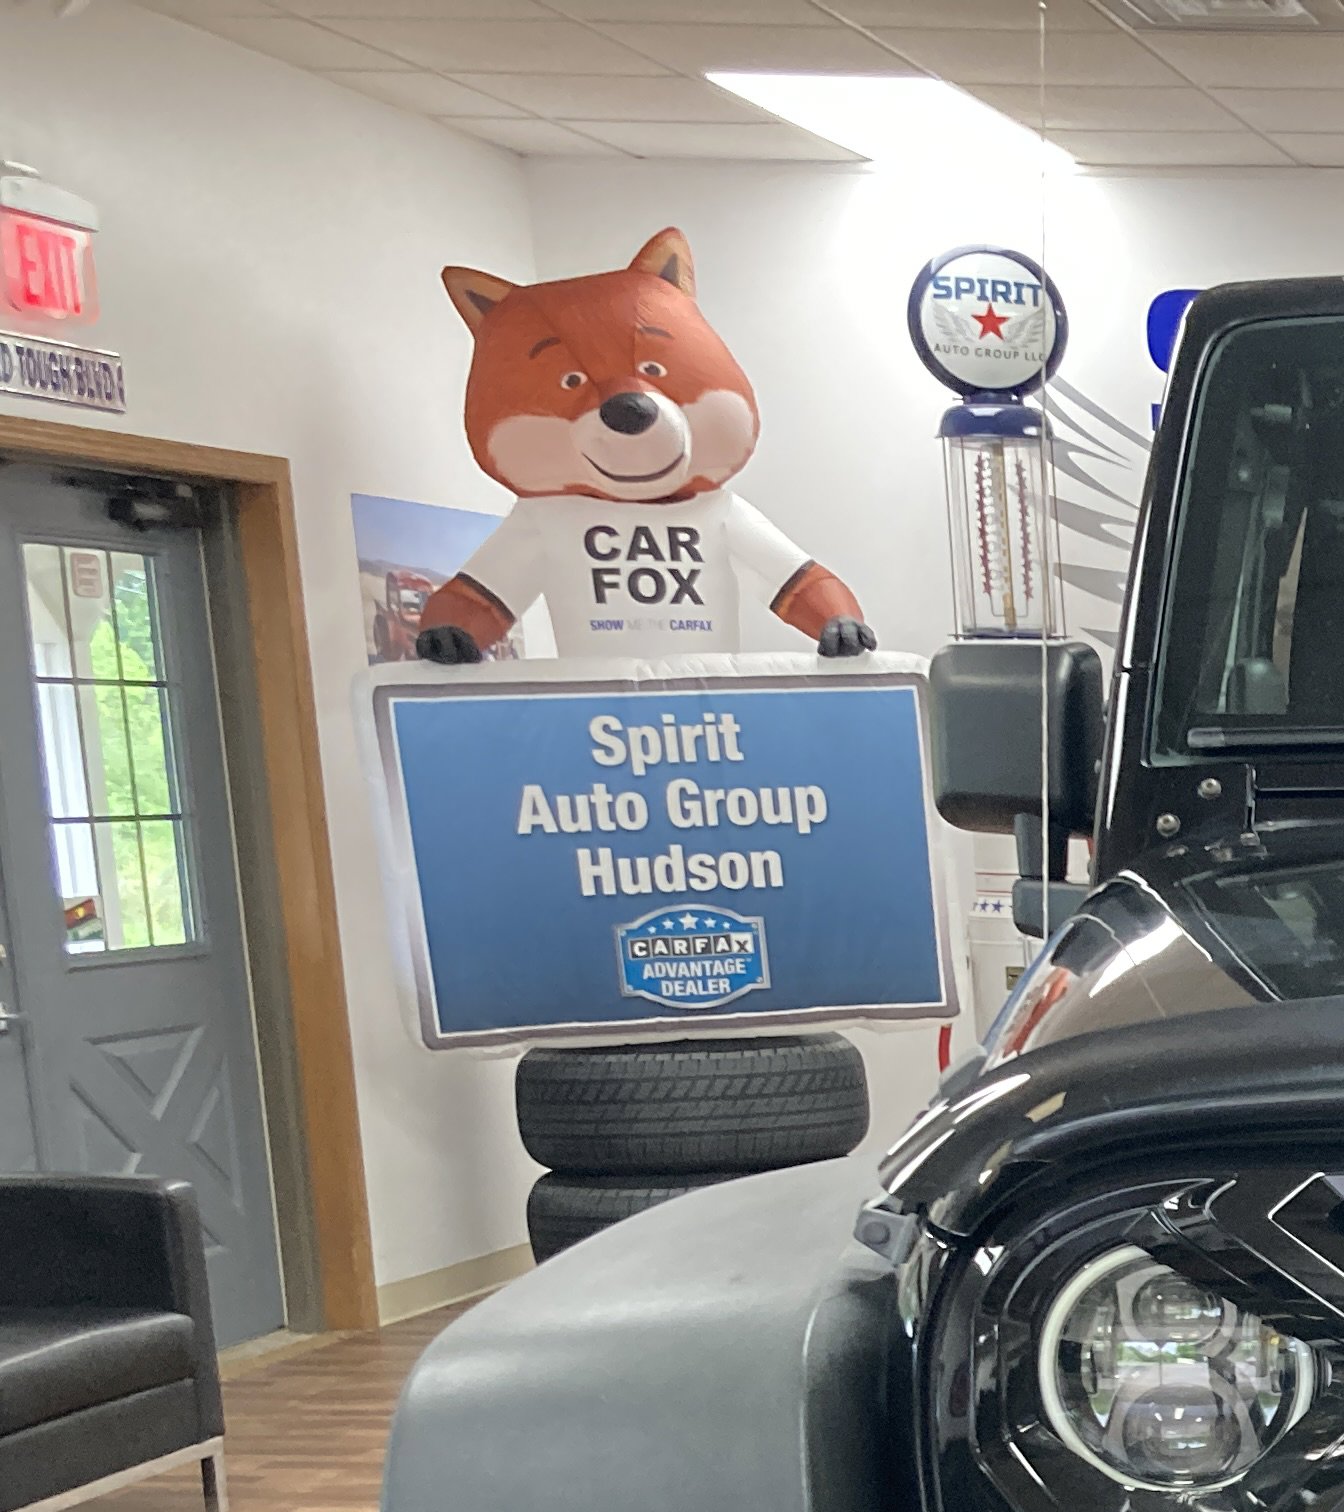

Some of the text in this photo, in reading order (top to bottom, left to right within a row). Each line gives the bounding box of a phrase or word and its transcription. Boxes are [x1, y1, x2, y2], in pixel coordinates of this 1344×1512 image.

[16, 224, 81, 314] EXIT
[932, 276, 1042, 307] SPIRIT
[15, 344, 74, 396] TOUGH
[933, 343, 969, 356] AUTO
[974, 347, 1020, 361] GROUP
[583, 524, 706, 563] CAR
[591, 567, 705, 605] FOX
[590, 619, 624, 632] SHOW
[669, 619, 713, 632] CARFAX
[588, 712, 745, 776] Spirit
[517, 778, 828, 835] Auto Group
[576, 844, 784, 897] Hudson
[631, 934, 752, 959] CARFAX
[642, 958, 747, 980] ADVANTAGE
[661, 978, 732, 997] DEALER
